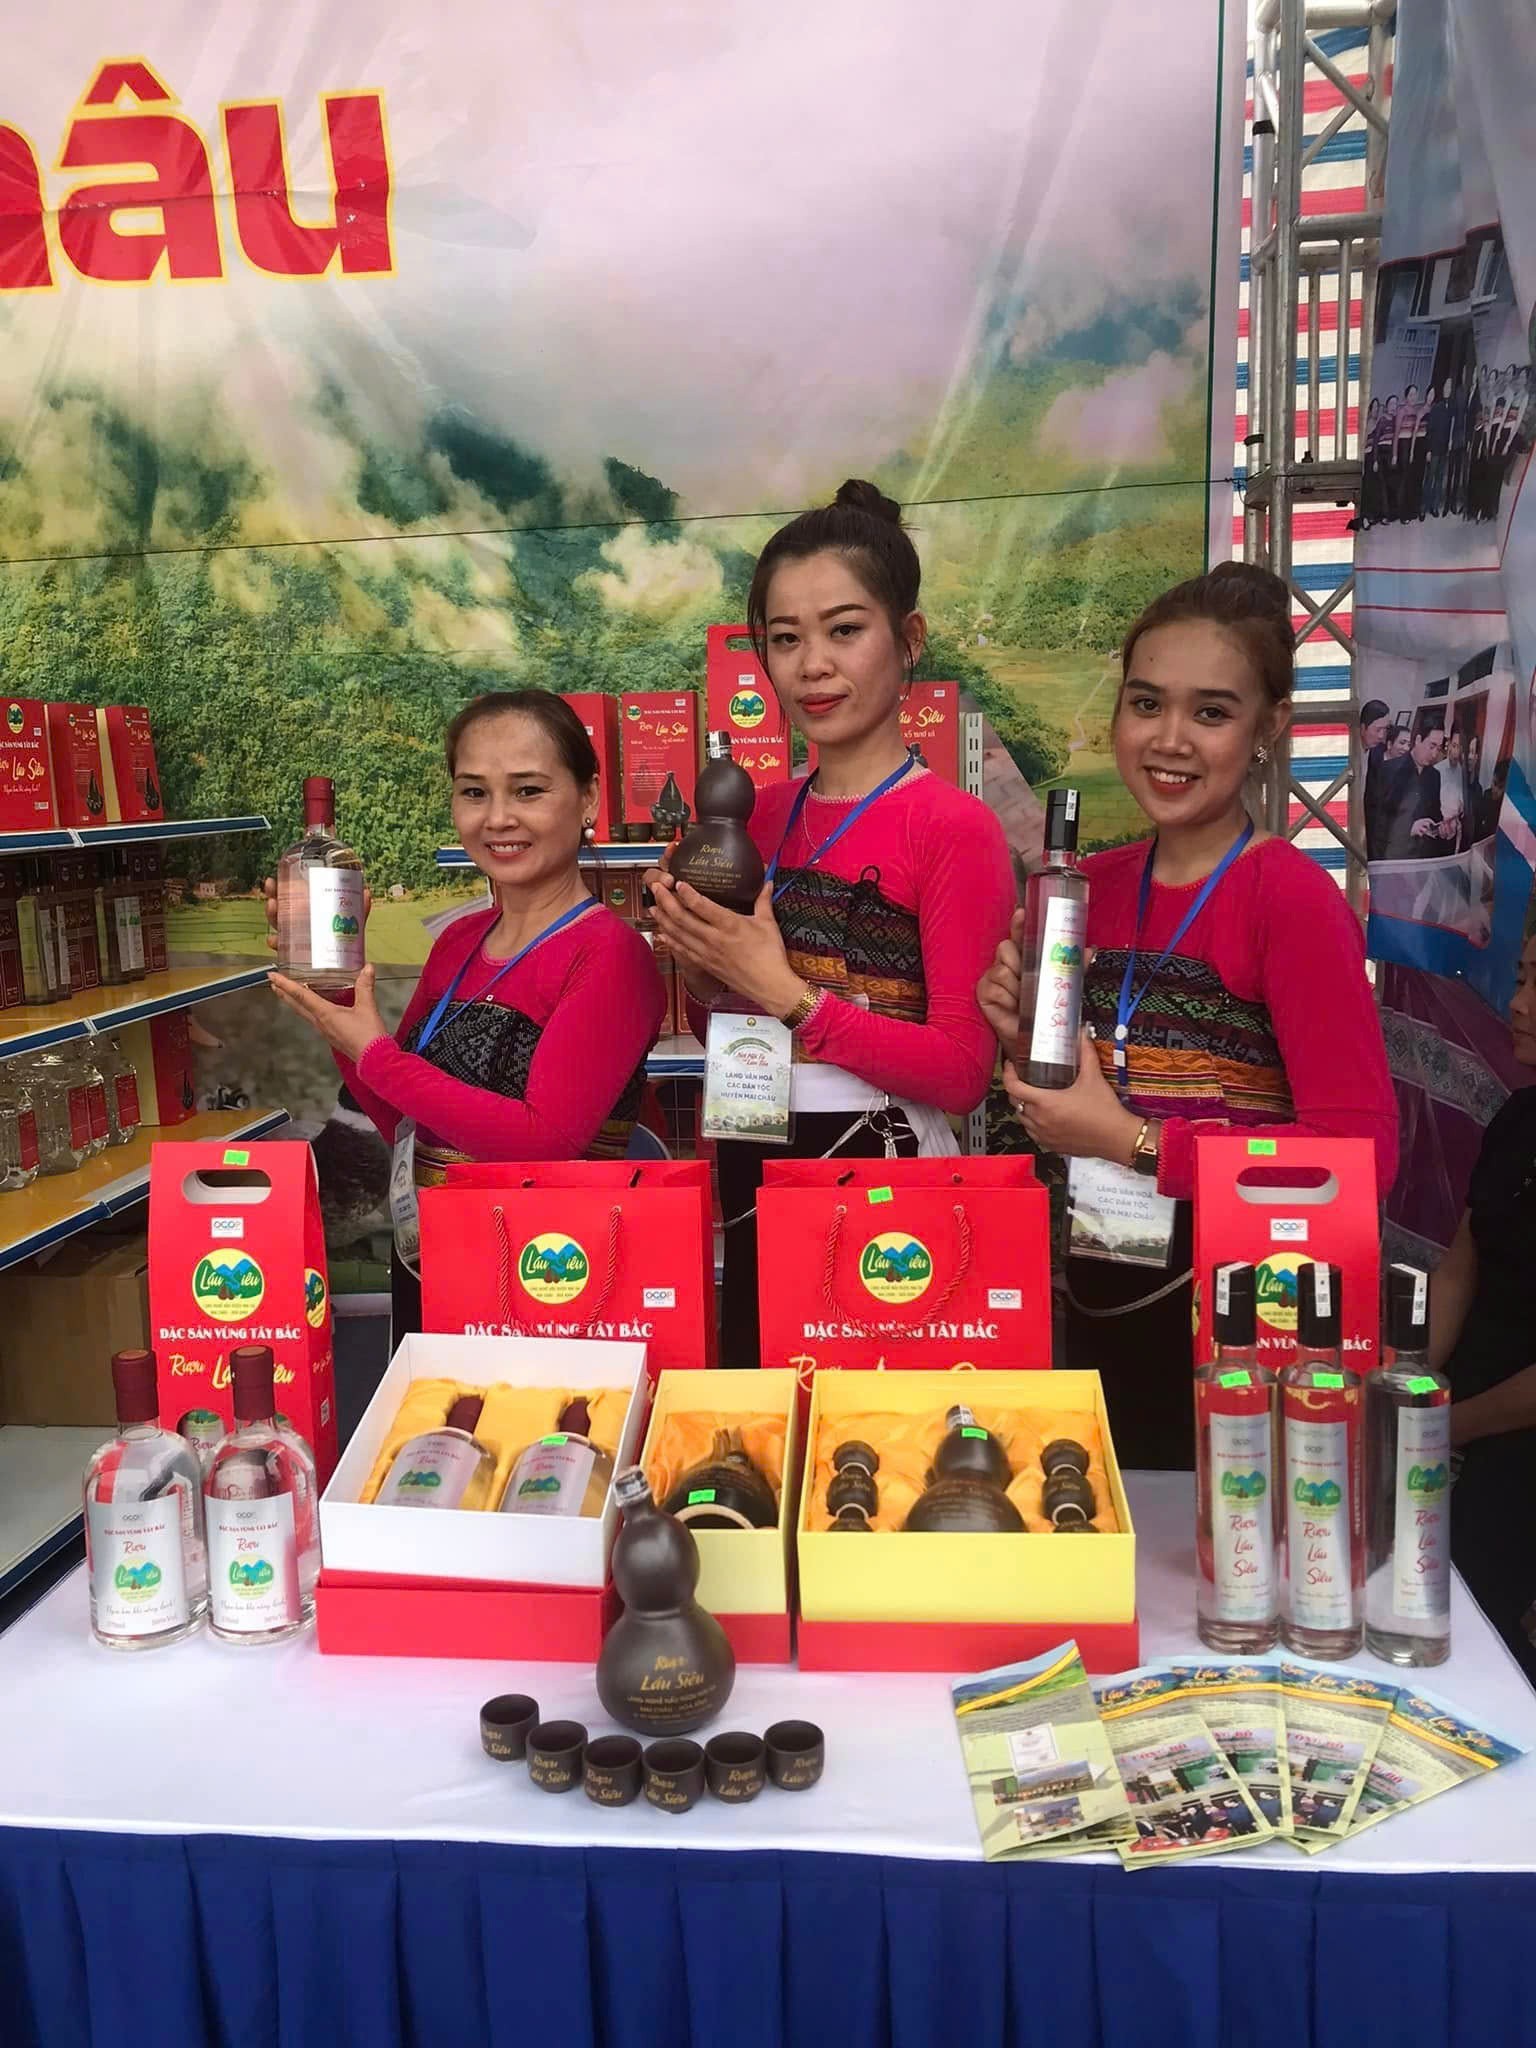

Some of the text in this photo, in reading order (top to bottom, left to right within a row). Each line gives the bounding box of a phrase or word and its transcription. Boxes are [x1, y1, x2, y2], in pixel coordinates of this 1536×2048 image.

[214, 1220, 241, 1229] OCOP
[1273, 1222, 1304, 1231] OCOP
[645, 1291, 672, 1301] OCOP
[990, 1292, 1019, 1302] OCOP
[159, 1324, 301, 1342] ĐẶC SẢN VÙNG TÂY BẮC
[586, 1321, 616, 1338] TÂY
[619, 1317, 653, 1338] BẮC
[803, 1321, 839, 1342] ĐẶC
[928, 1321, 961, 1339] TÂY
[963, 1317, 999, 1339] BẮC
[1272, 1334, 1298, 1349] VÙN
[1342, 1334, 1373, 1350] BẮC
[168, 1353, 206, 1377] Rượu
[640, 1671, 705, 1691] Láu Siêu
